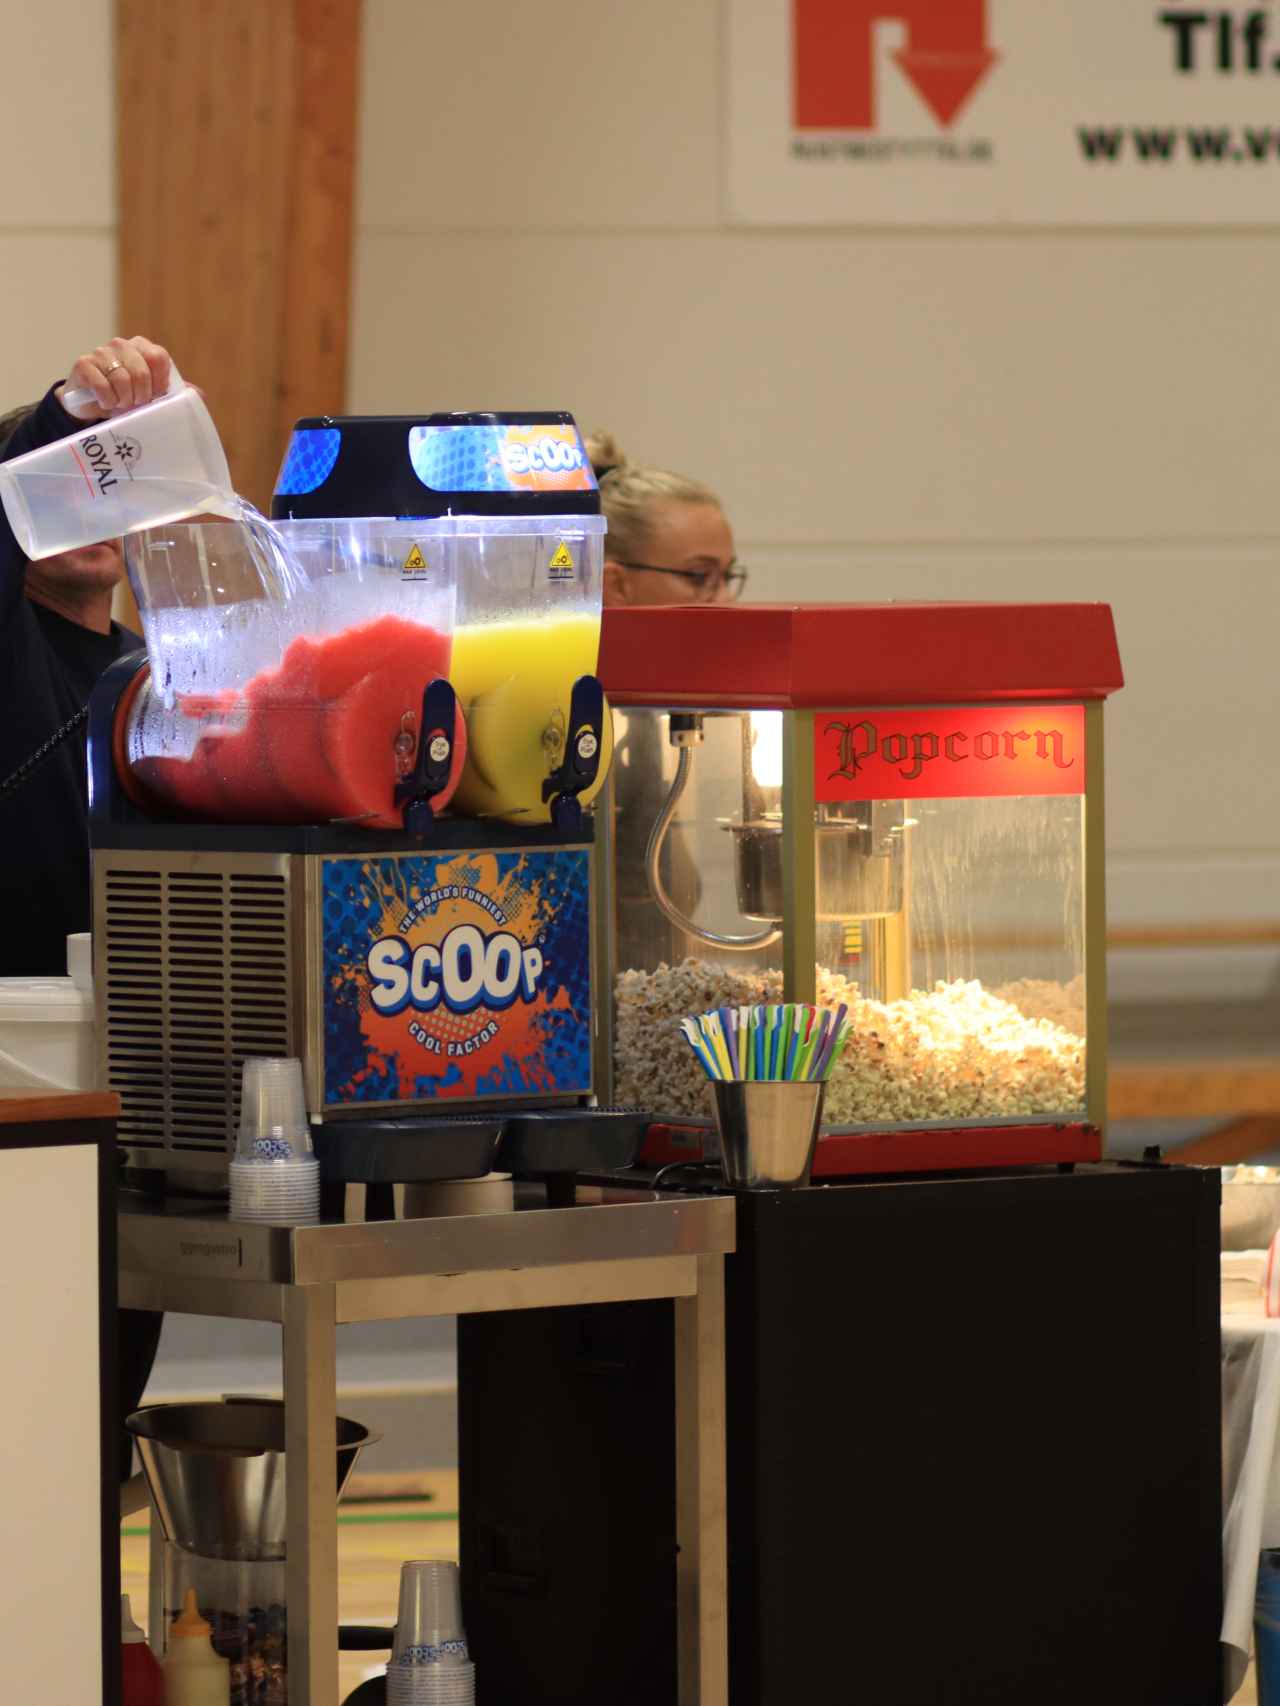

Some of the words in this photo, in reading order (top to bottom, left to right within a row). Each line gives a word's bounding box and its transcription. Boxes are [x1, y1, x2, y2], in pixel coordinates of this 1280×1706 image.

[1077, 126, 1280, 163] www.v
[80, 433, 118, 496] ROYAL
[823, 719, 1075, 782] Popcorn
[399, 910, 418, 934] THE
[414, 885, 460, 913] WORLD'S
[461, 885, 508, 927] FUNNIEST
[408, 1021, 442, 1055] COOL
[447, 1021, 500, 1057] FACTOR
